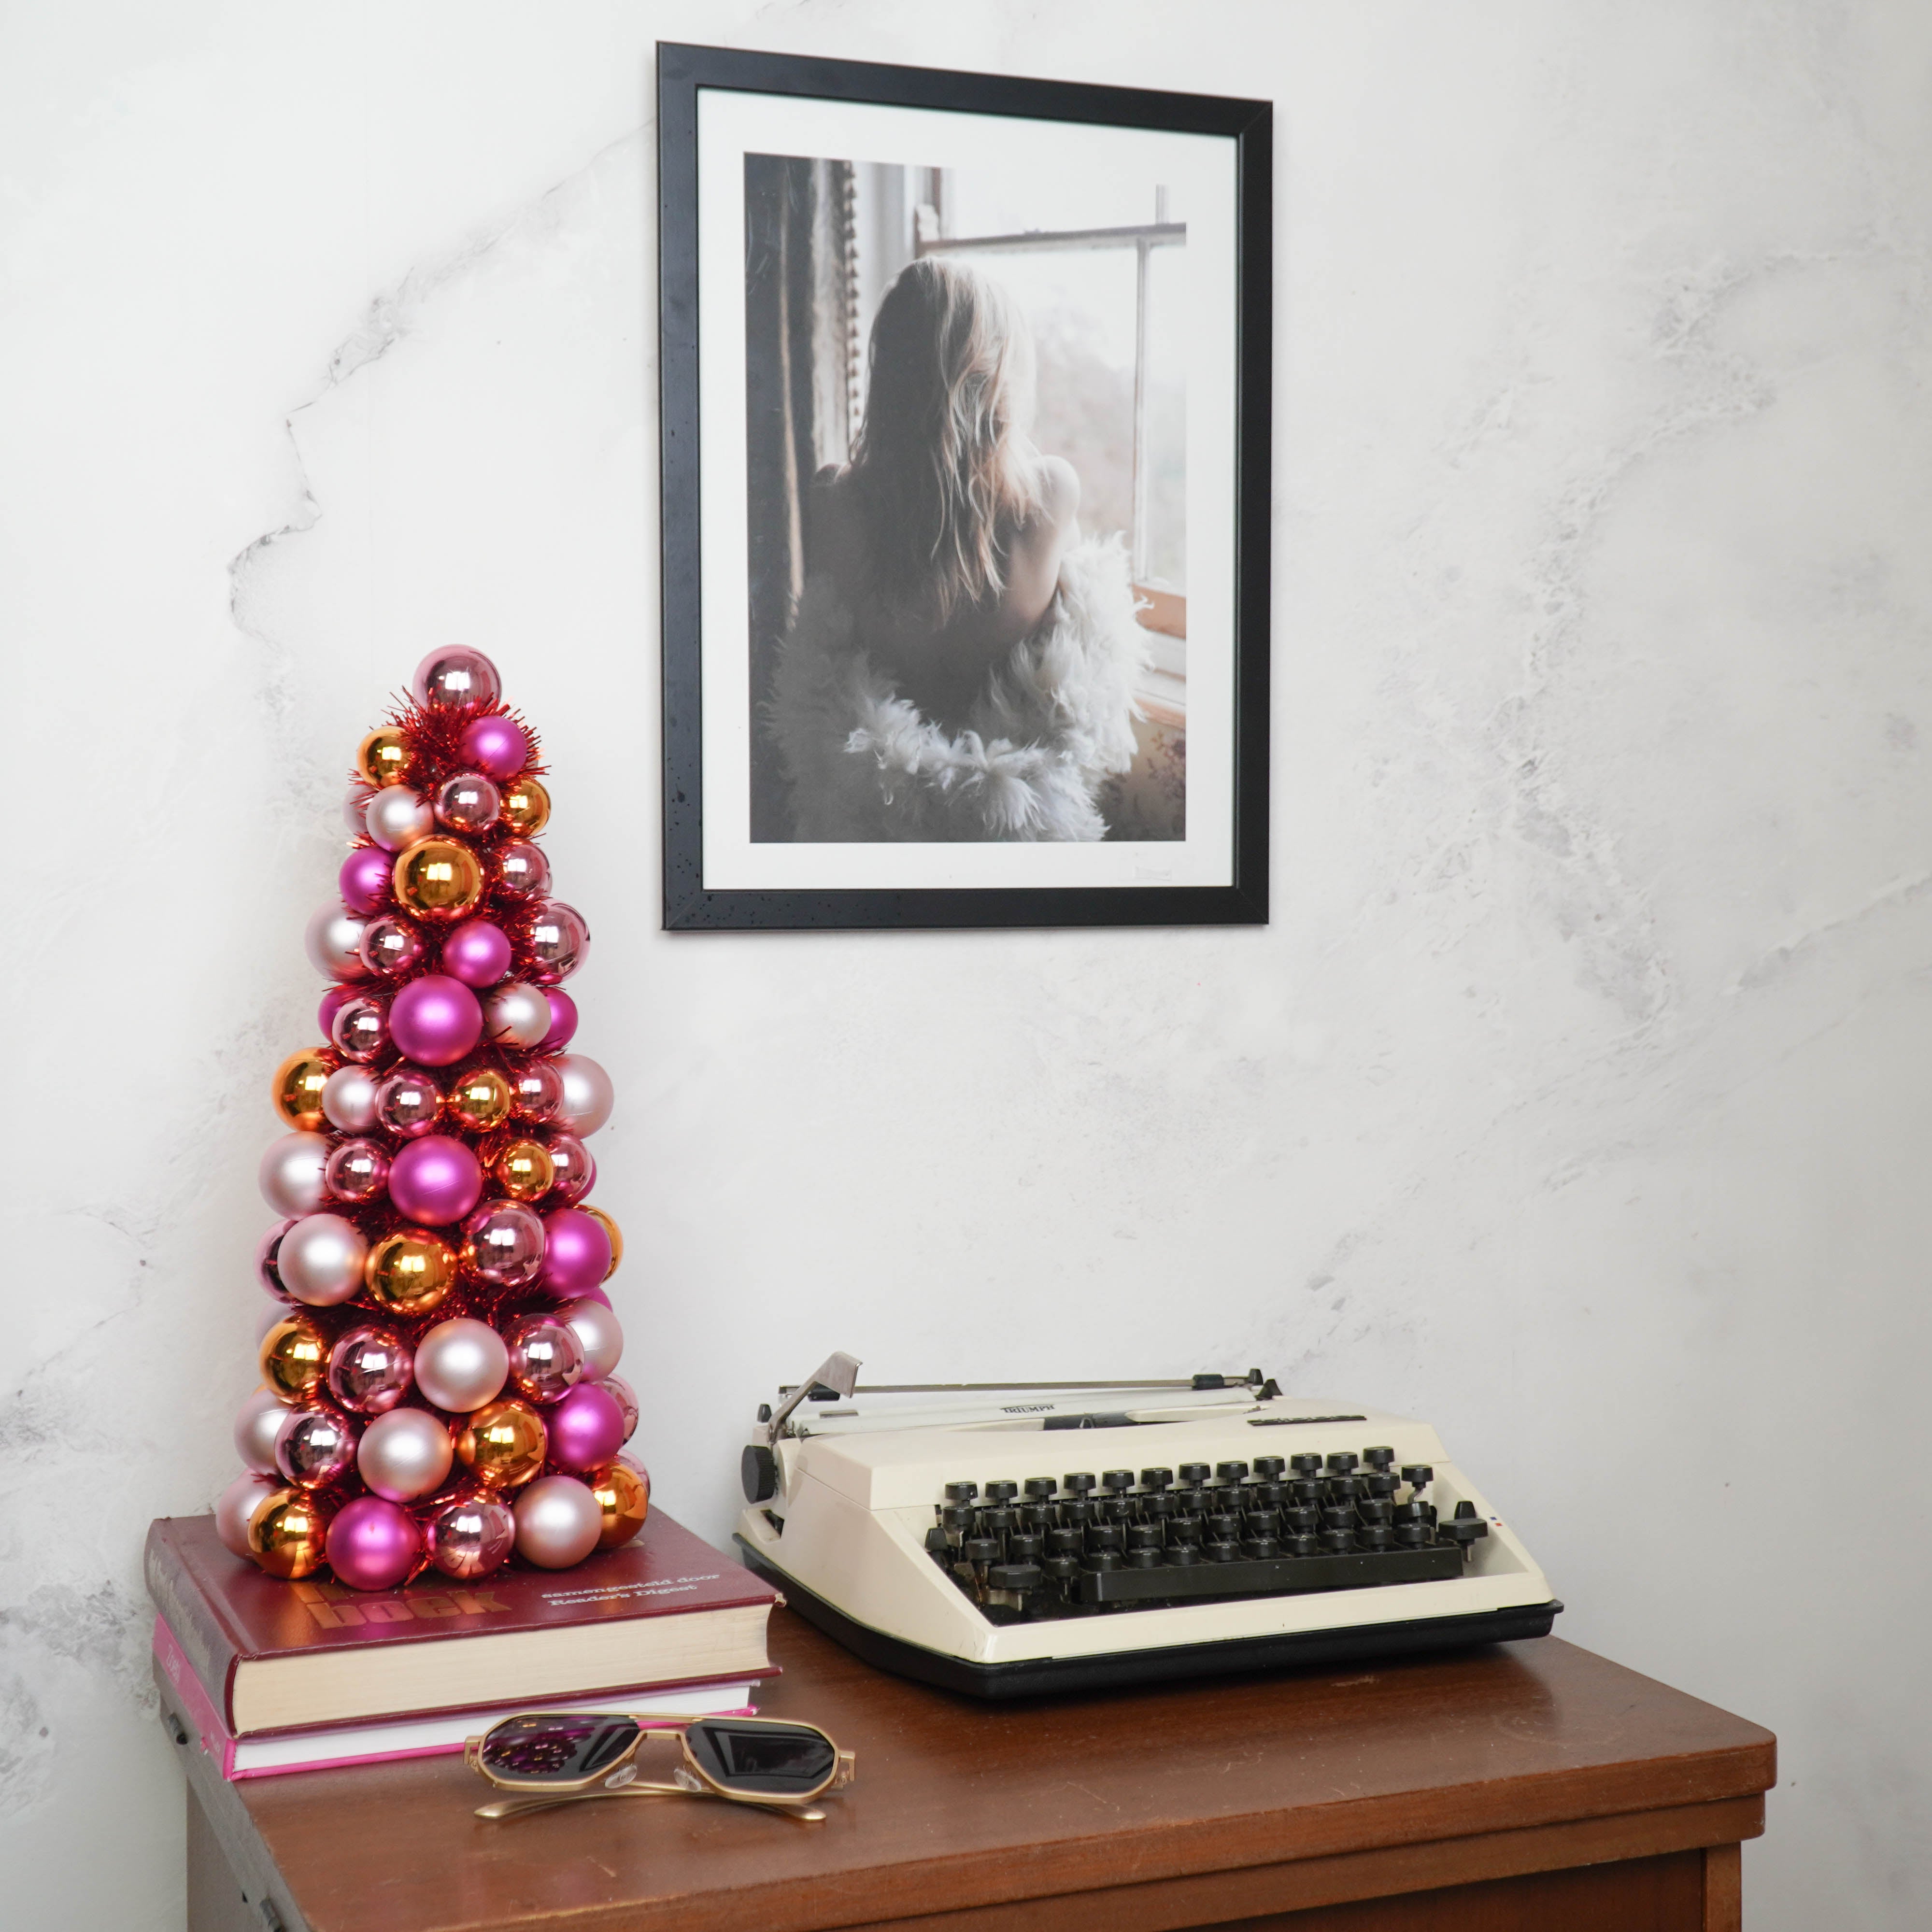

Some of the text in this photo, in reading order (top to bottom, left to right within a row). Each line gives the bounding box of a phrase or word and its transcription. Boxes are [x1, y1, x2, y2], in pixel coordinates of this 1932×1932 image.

[1000, 1404, 1055, 1413] TRIUMPH
[541, 1574, 720, 1598] samengesteld door
[548, 1585, 697, 1606] Reader's Digest
[306, 1590, 512, 1629] boek
